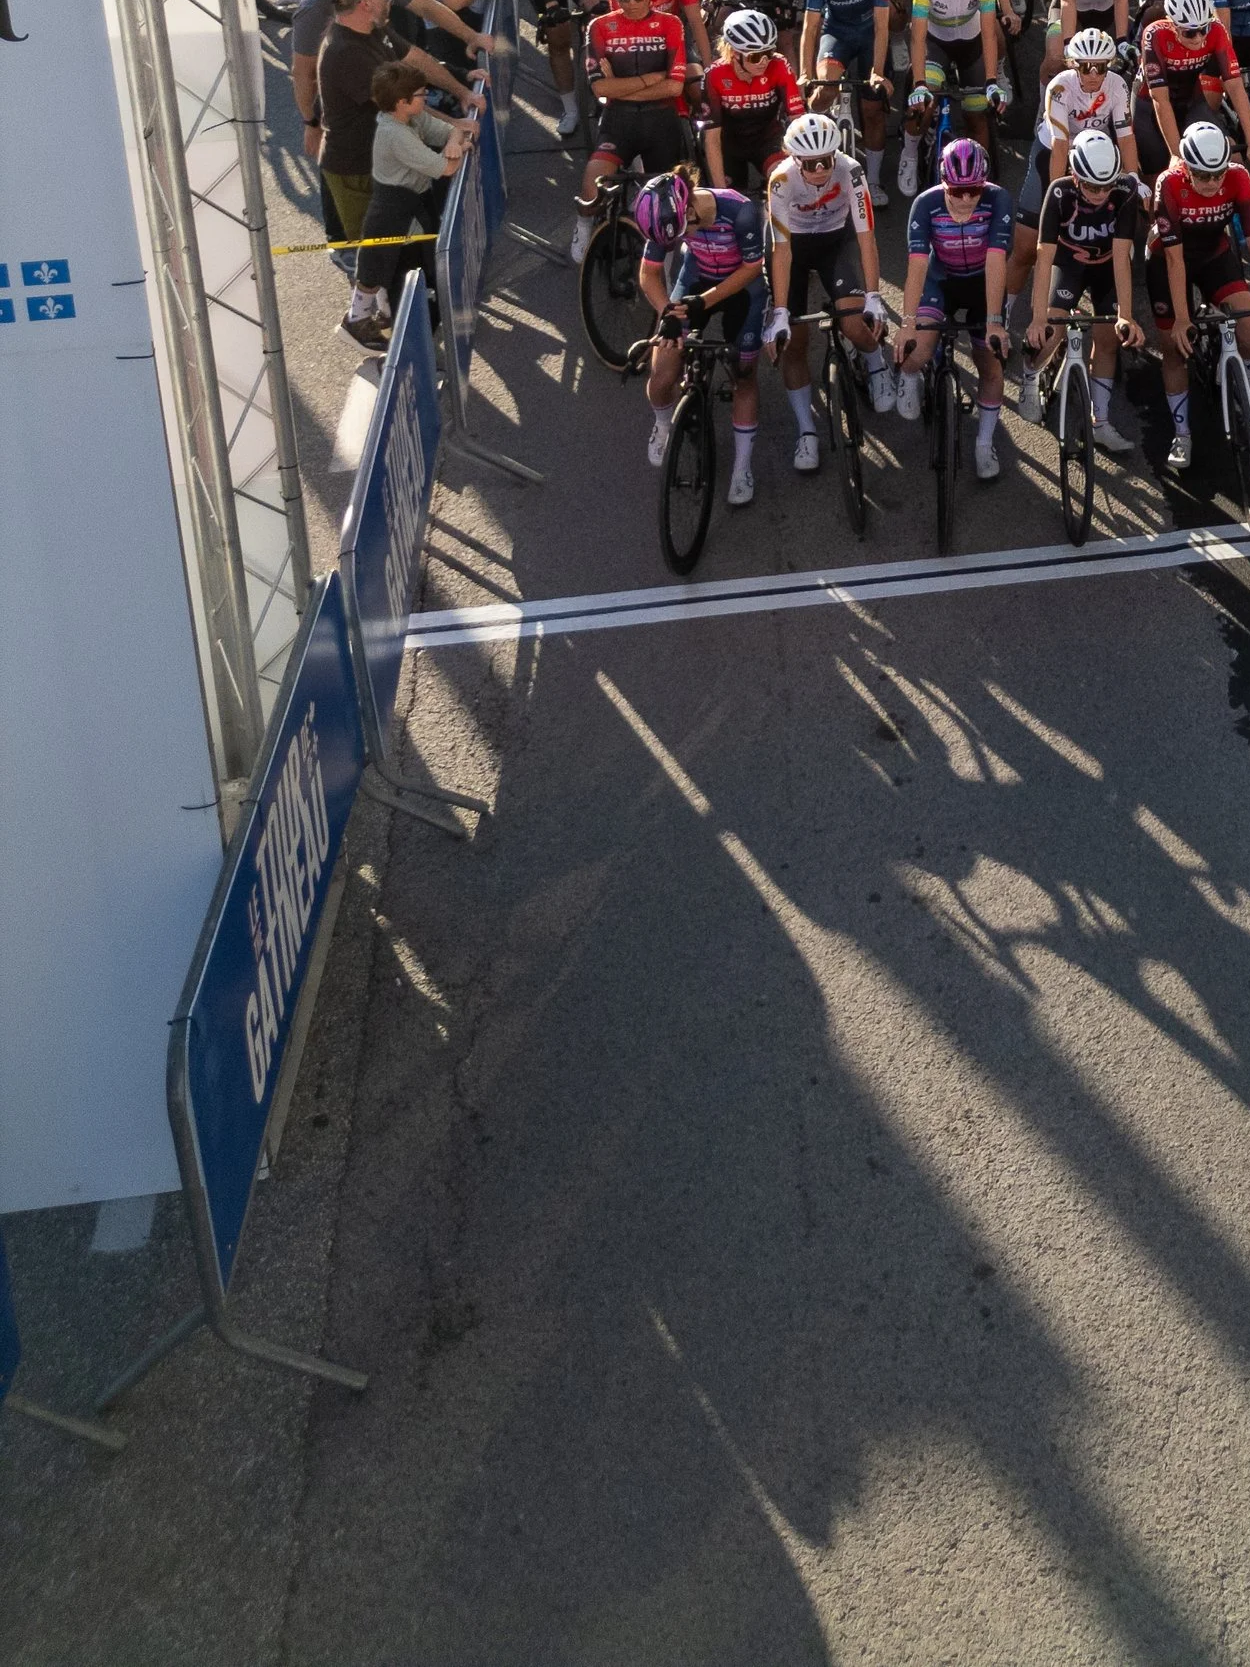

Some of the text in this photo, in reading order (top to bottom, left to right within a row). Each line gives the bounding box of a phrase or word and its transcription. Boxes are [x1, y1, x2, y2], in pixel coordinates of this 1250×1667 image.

[629, 36, 666, 44] TRUCK
[605, 44, 667, 52] RACING
[744, 89, 776, 101] TRUCK
[721, 96, 778, 110] RACING
[855, 191, 866, 220] place
[1198, 201, 1234, 215] TRUCK
[246, 759, 329, 1104] GATINEAU
